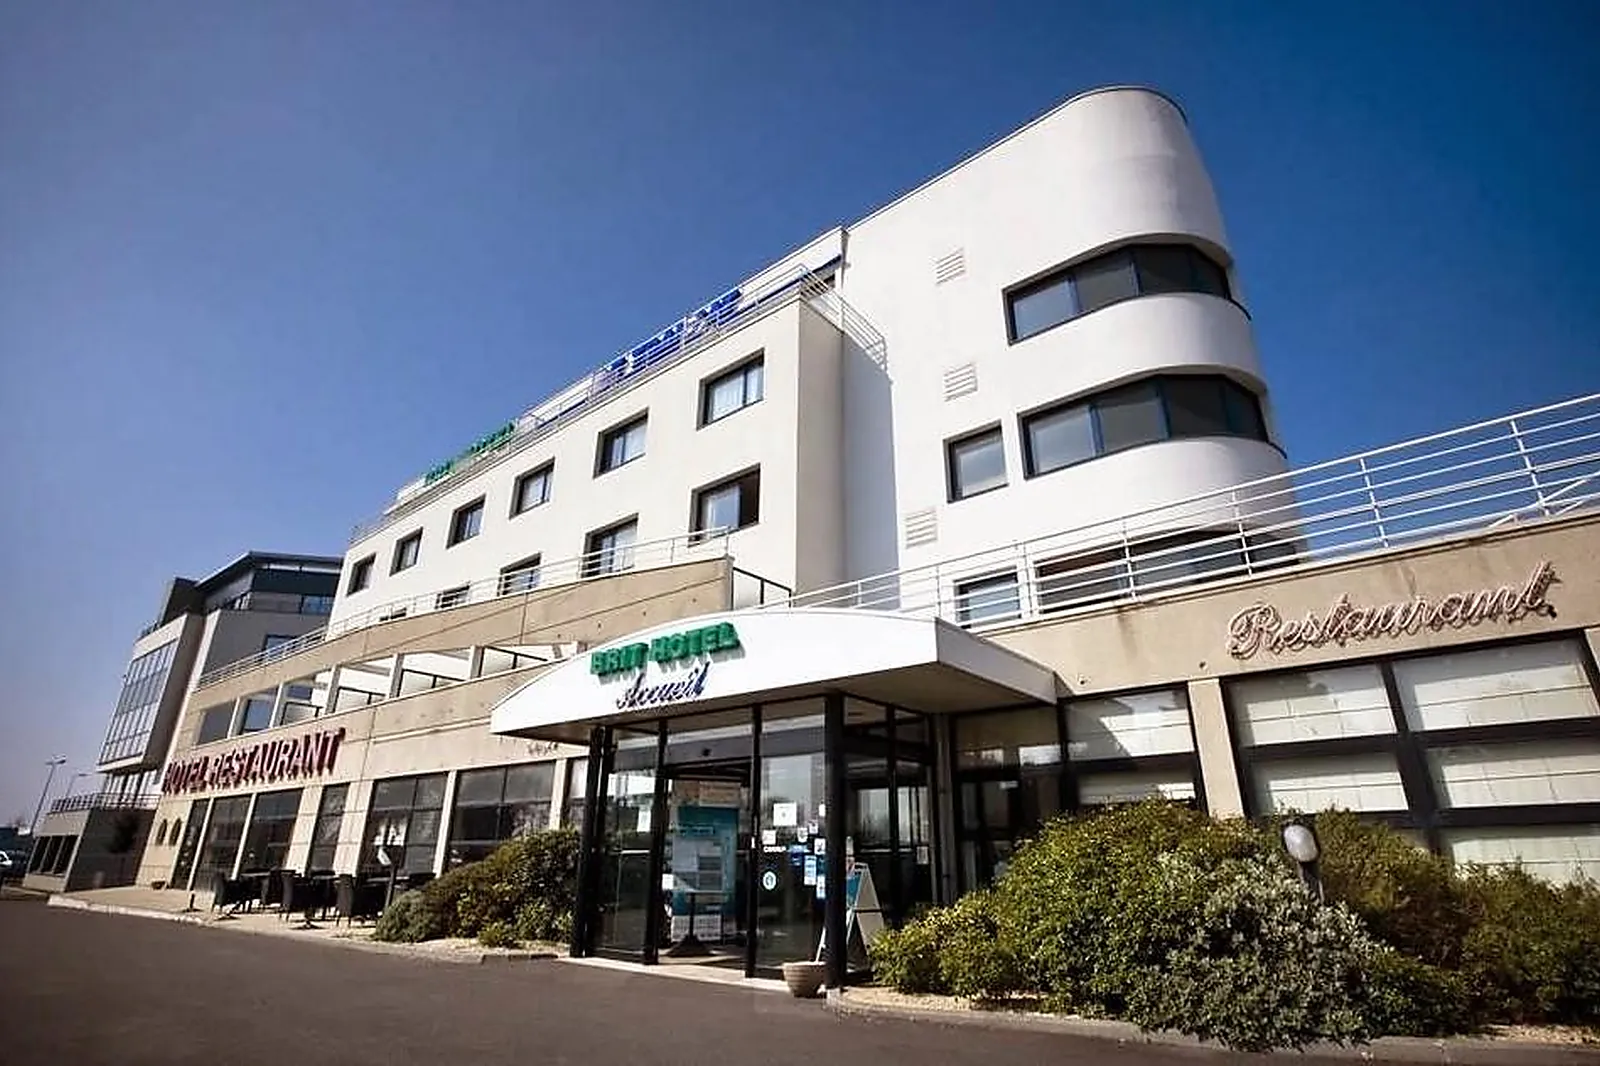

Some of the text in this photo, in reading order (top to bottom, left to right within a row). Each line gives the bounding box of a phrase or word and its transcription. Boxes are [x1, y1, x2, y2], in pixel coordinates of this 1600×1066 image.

[1226, 560, 1558, 660] Restaurant
[590, 621, 742, 676] BRIT HOTEL
[161, 727, 347, 795] HOTEL RESTAURANT
